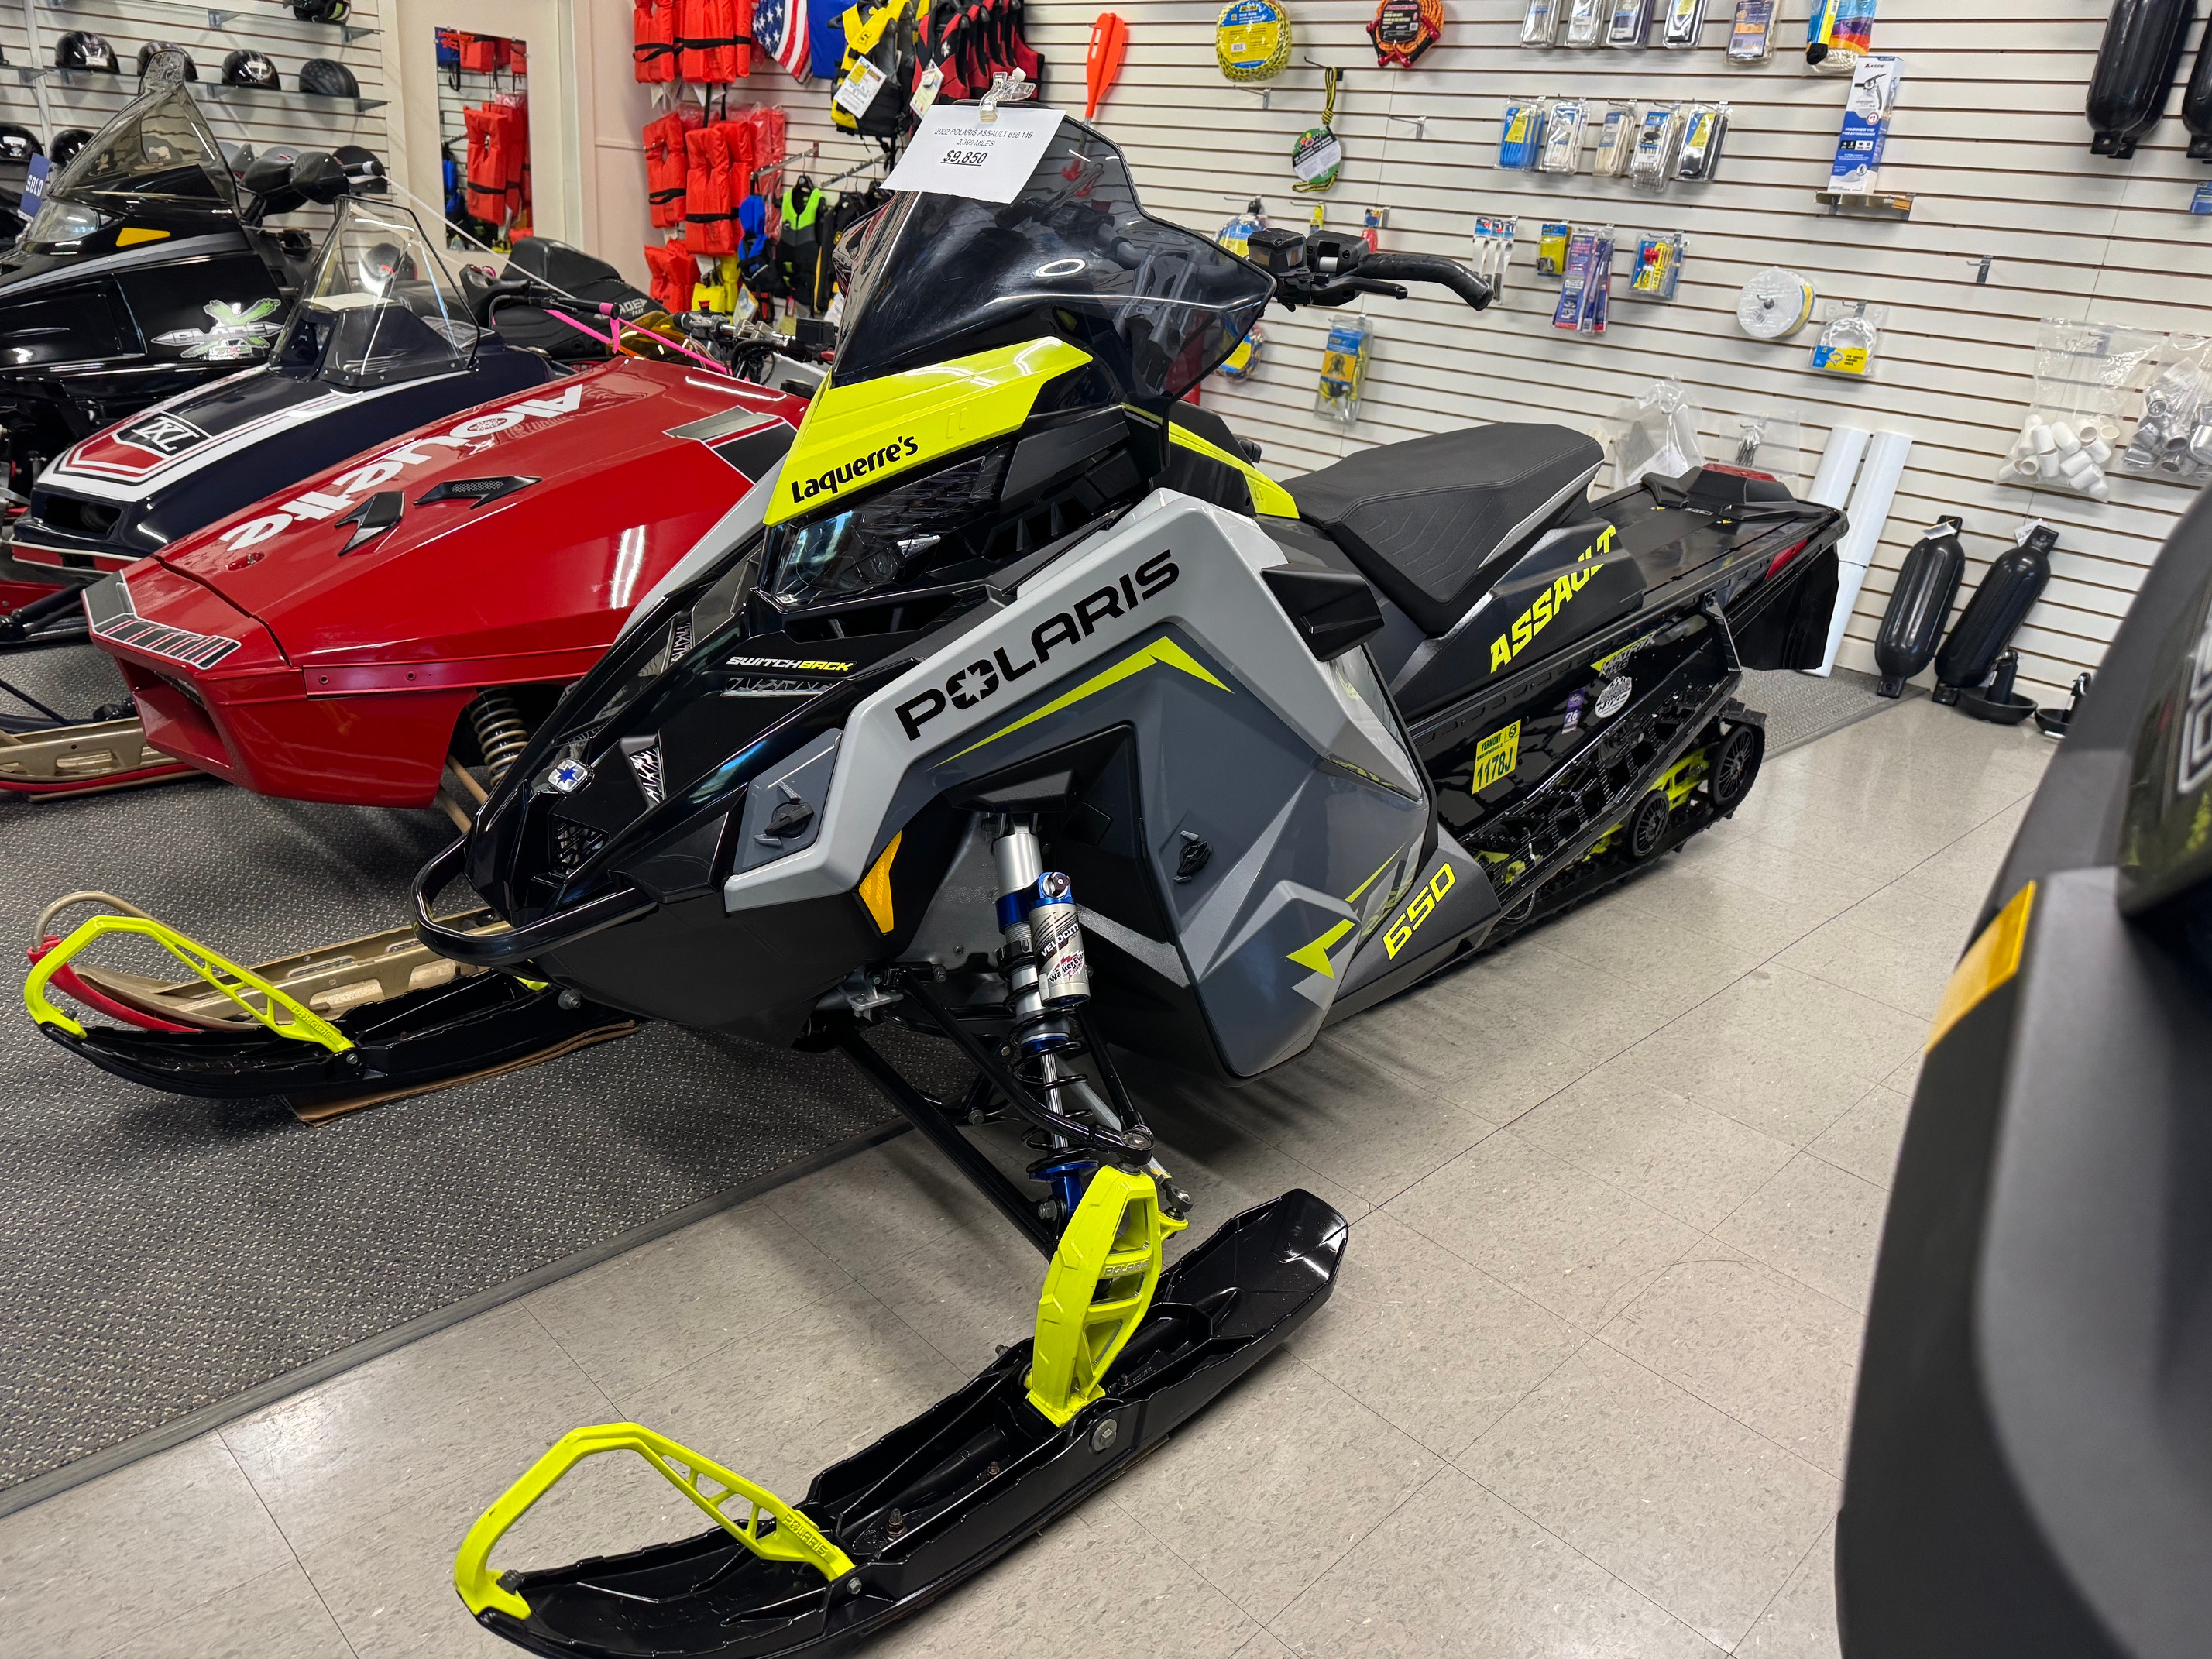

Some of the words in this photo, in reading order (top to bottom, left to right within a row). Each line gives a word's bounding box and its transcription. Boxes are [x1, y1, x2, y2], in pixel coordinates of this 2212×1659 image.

[942, 149, 988, 164] $9,850
[26, 174, 43, 198] SOLD
[791, 435, 919, 504] Laquerre's
[1490, 524, 1616, 674] ASSAULT
[895, 548, 1180, 742] POLARIS
[1599, 630, 1657, 678] MATRYX
[726, 656, 854, 672] SWITCHBACK
[1565, 709, 1578, 723] 26
[1481, 733, 1503, 753] VERMONT
[1477, 747, 1513, 788] 1178J
[1382, 862, 1456, 960] 650
[1041, 922, 1079, 957] VELOCITY
[292, 1005, 334, 1040] POLARIS
[1103, 1258, 1150, 1276] POLARIS
[781, 1513, 829, 1558] POLARIS
